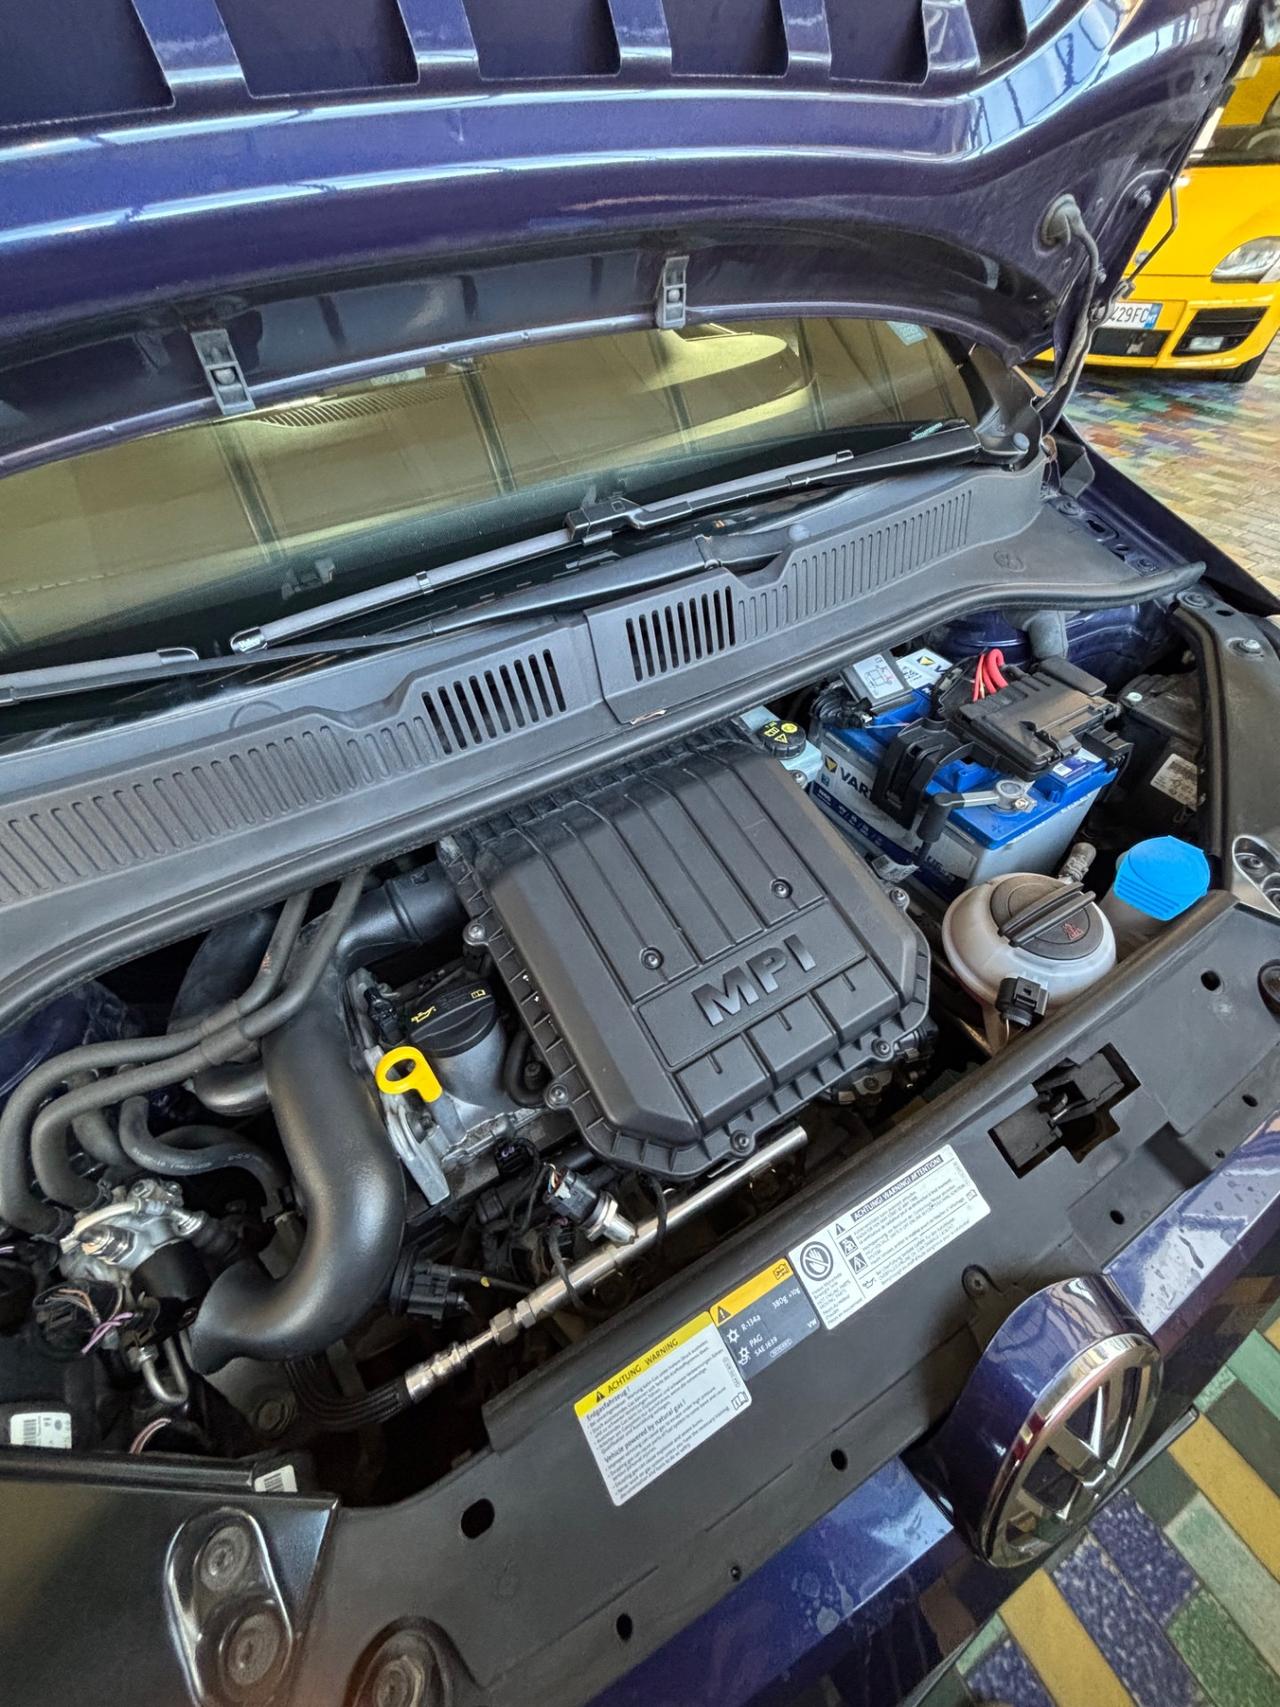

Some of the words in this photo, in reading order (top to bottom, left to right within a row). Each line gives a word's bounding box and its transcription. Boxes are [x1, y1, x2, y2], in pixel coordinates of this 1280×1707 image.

[839, 767, 873, 801] VAR
[691, 934, 816, 1026] MPI
[606, 1363, 642, 1393] ACHTUNG
[644, 1337, 678, 1365] WARNING
[748, 1333, 763, 1347] PAG
[604, 1444, 624, 1463] Vehicle
[623, 1427, 648, 1450] powered
[646, 1421, 655, 1433] by
[653, 1407, 674, 1426] natural
[673, 1400, 684, 1413] gas
